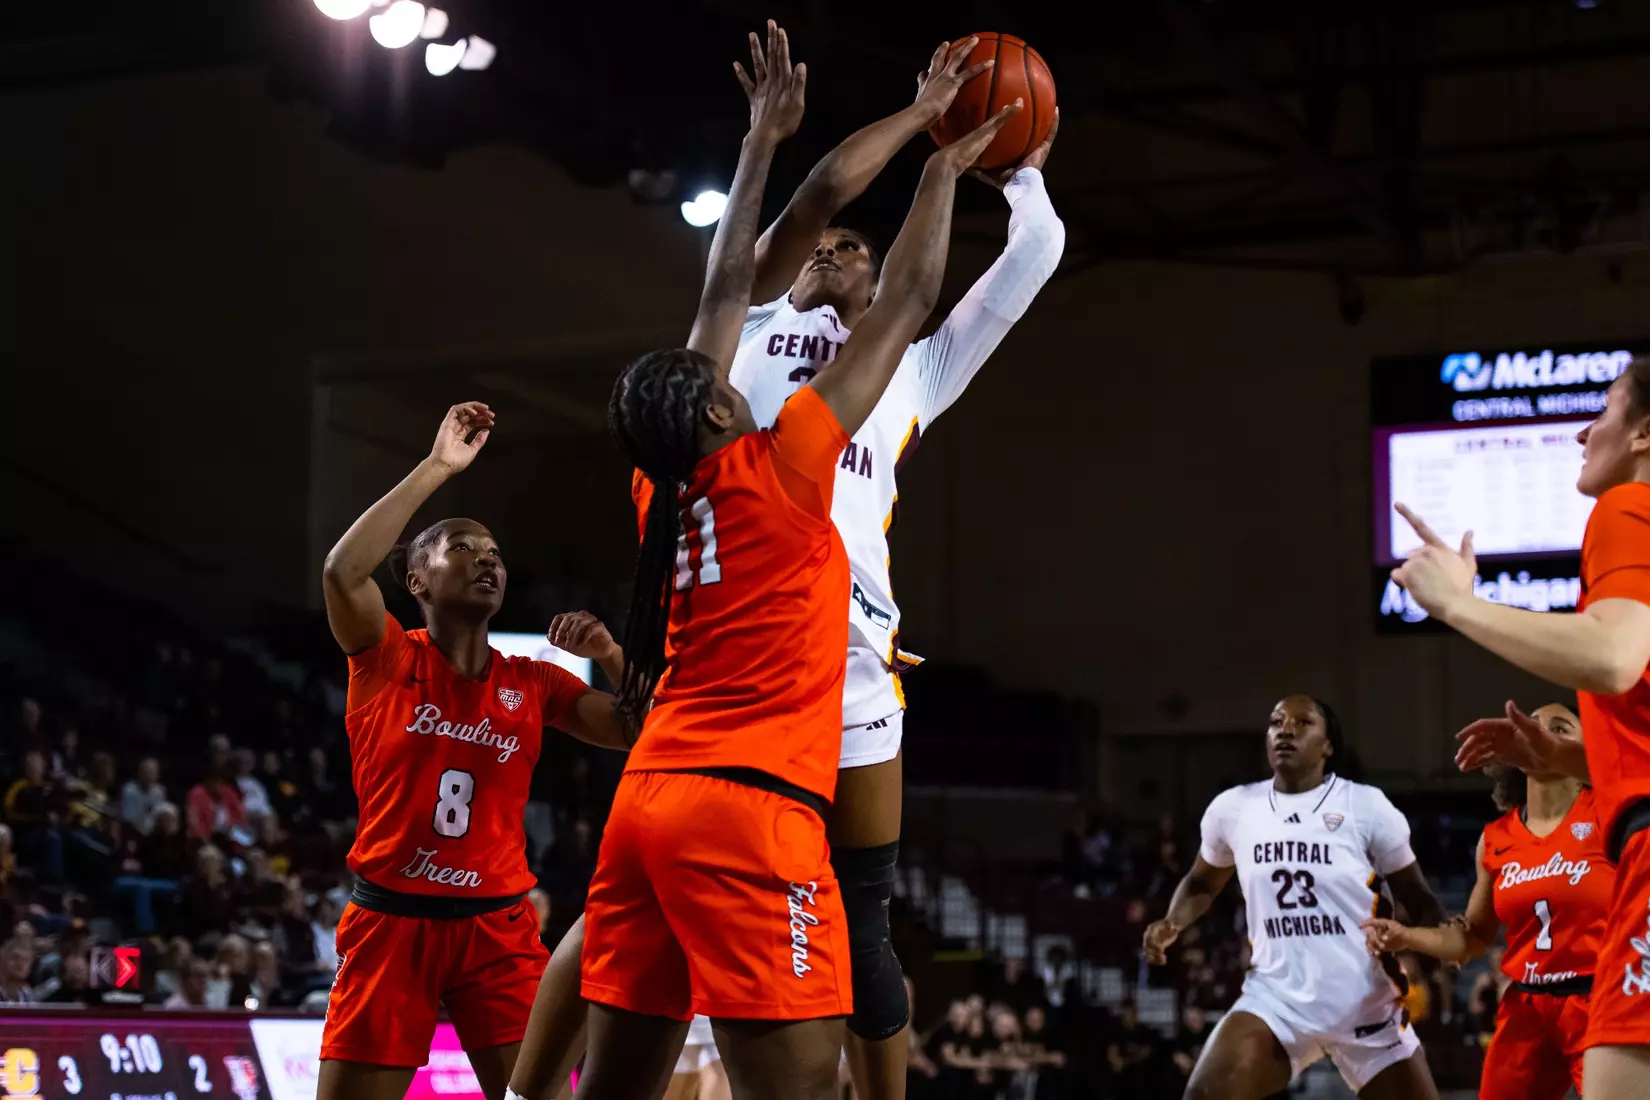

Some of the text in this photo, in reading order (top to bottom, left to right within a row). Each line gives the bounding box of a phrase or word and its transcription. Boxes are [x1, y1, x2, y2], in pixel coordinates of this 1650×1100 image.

[1492, 350, 1632, 389] McLaren
[406, 703, 520, 763] Bowling
[432, 768, 474, 839] 8
[400, 846, 482, 888] Green
[1254, 841, 1332, 865] CENTRAL
[1499, 852, 1591, 890] Bowling
[1271, 869, 1318, 910] 23
[787, 881, 819, 978] Falcons
[1264, 915, 1346, 939] MICHIGAN
[1534, 900, 1552, 950] 1
[100, 1034, 163, 1074] 9:10
[188, 1055, 213, 1093] 2
[58, 1055, 83, 1095] 3
